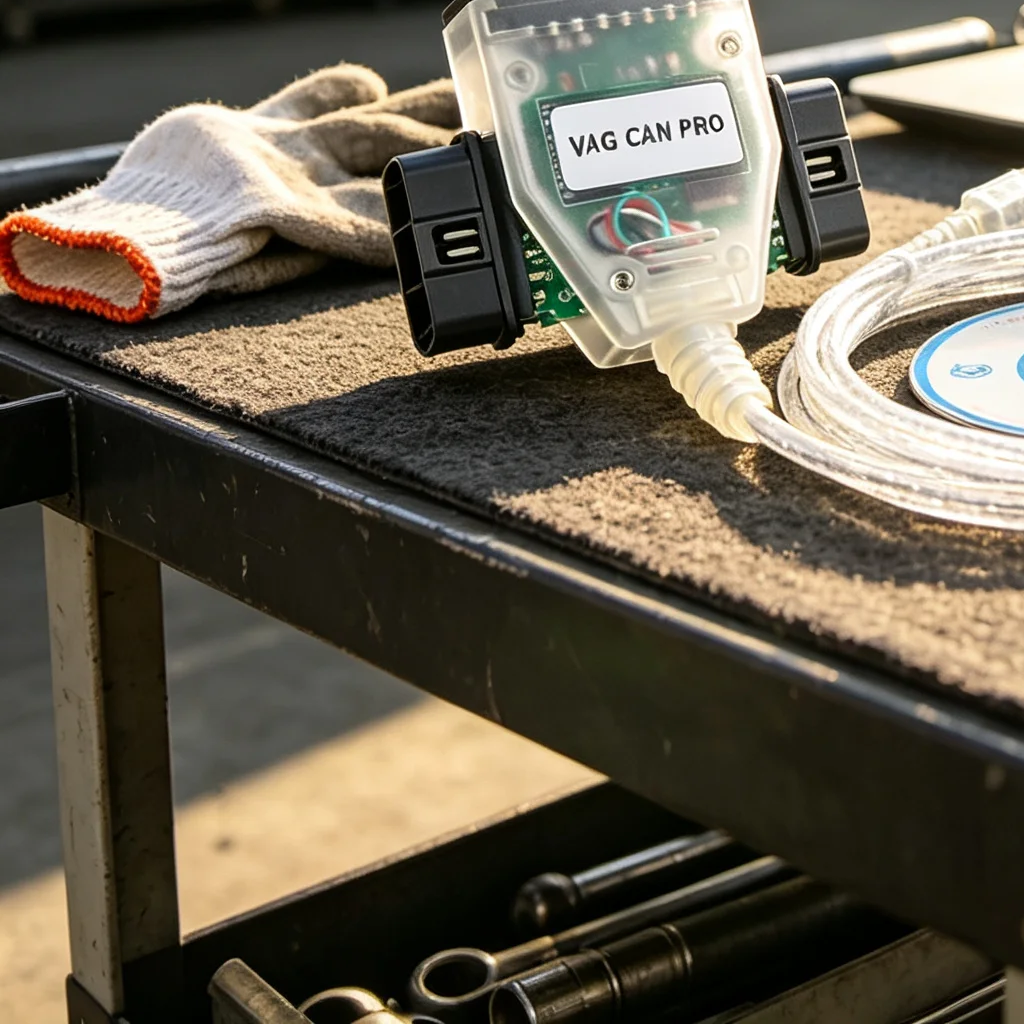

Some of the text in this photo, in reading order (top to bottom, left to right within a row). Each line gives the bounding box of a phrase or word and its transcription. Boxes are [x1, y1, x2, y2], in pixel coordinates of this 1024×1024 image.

[568, 114, 725, 158] VAG CAN PRO
